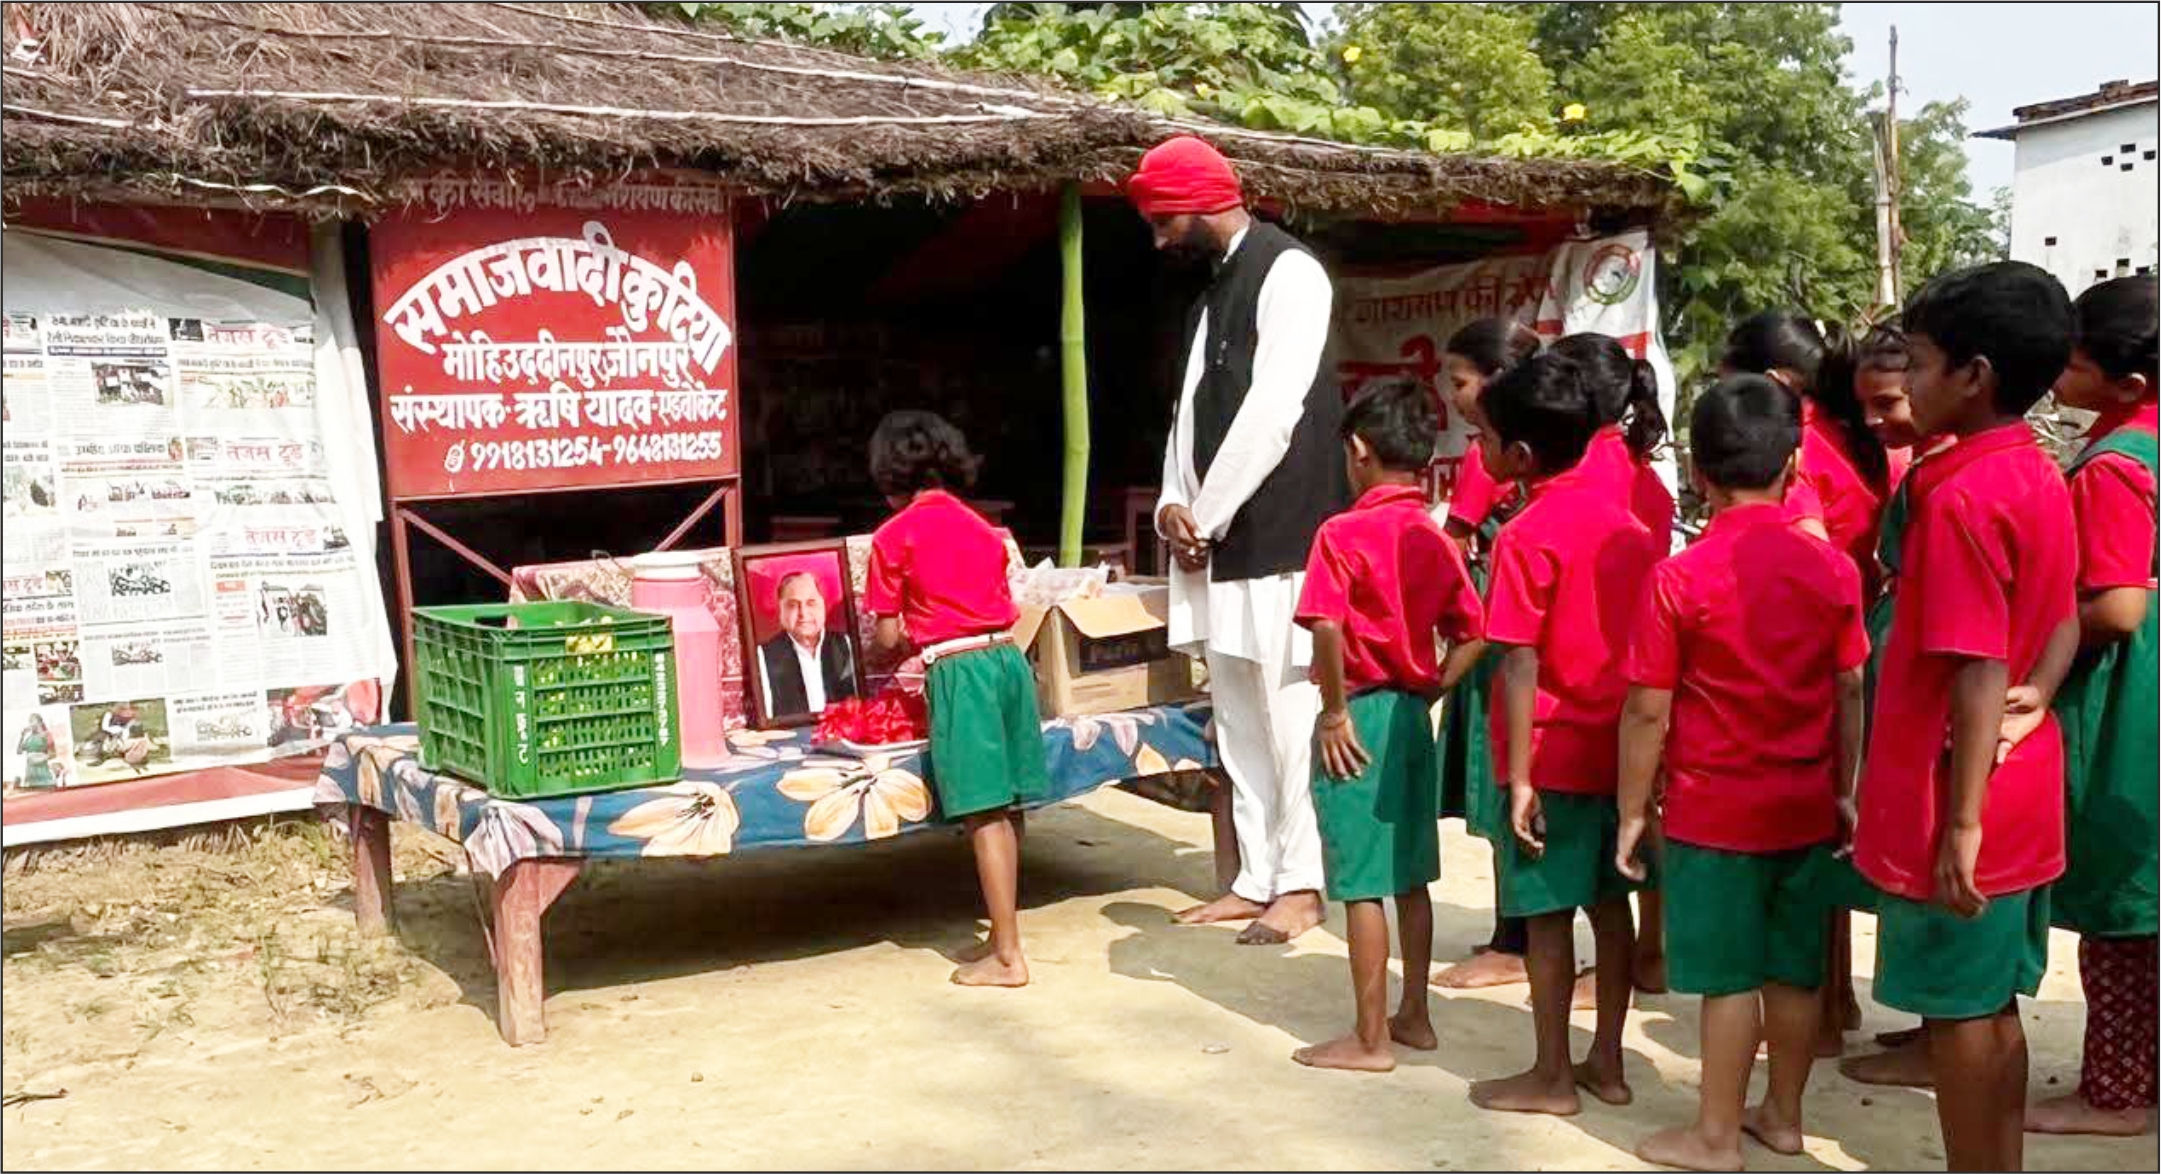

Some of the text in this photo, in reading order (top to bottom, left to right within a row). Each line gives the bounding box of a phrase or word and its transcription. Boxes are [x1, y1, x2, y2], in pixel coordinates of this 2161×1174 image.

[383, 221, 732, 375] समाजवादी कुटिया
[513, 381, 582, 429] ऋषि
